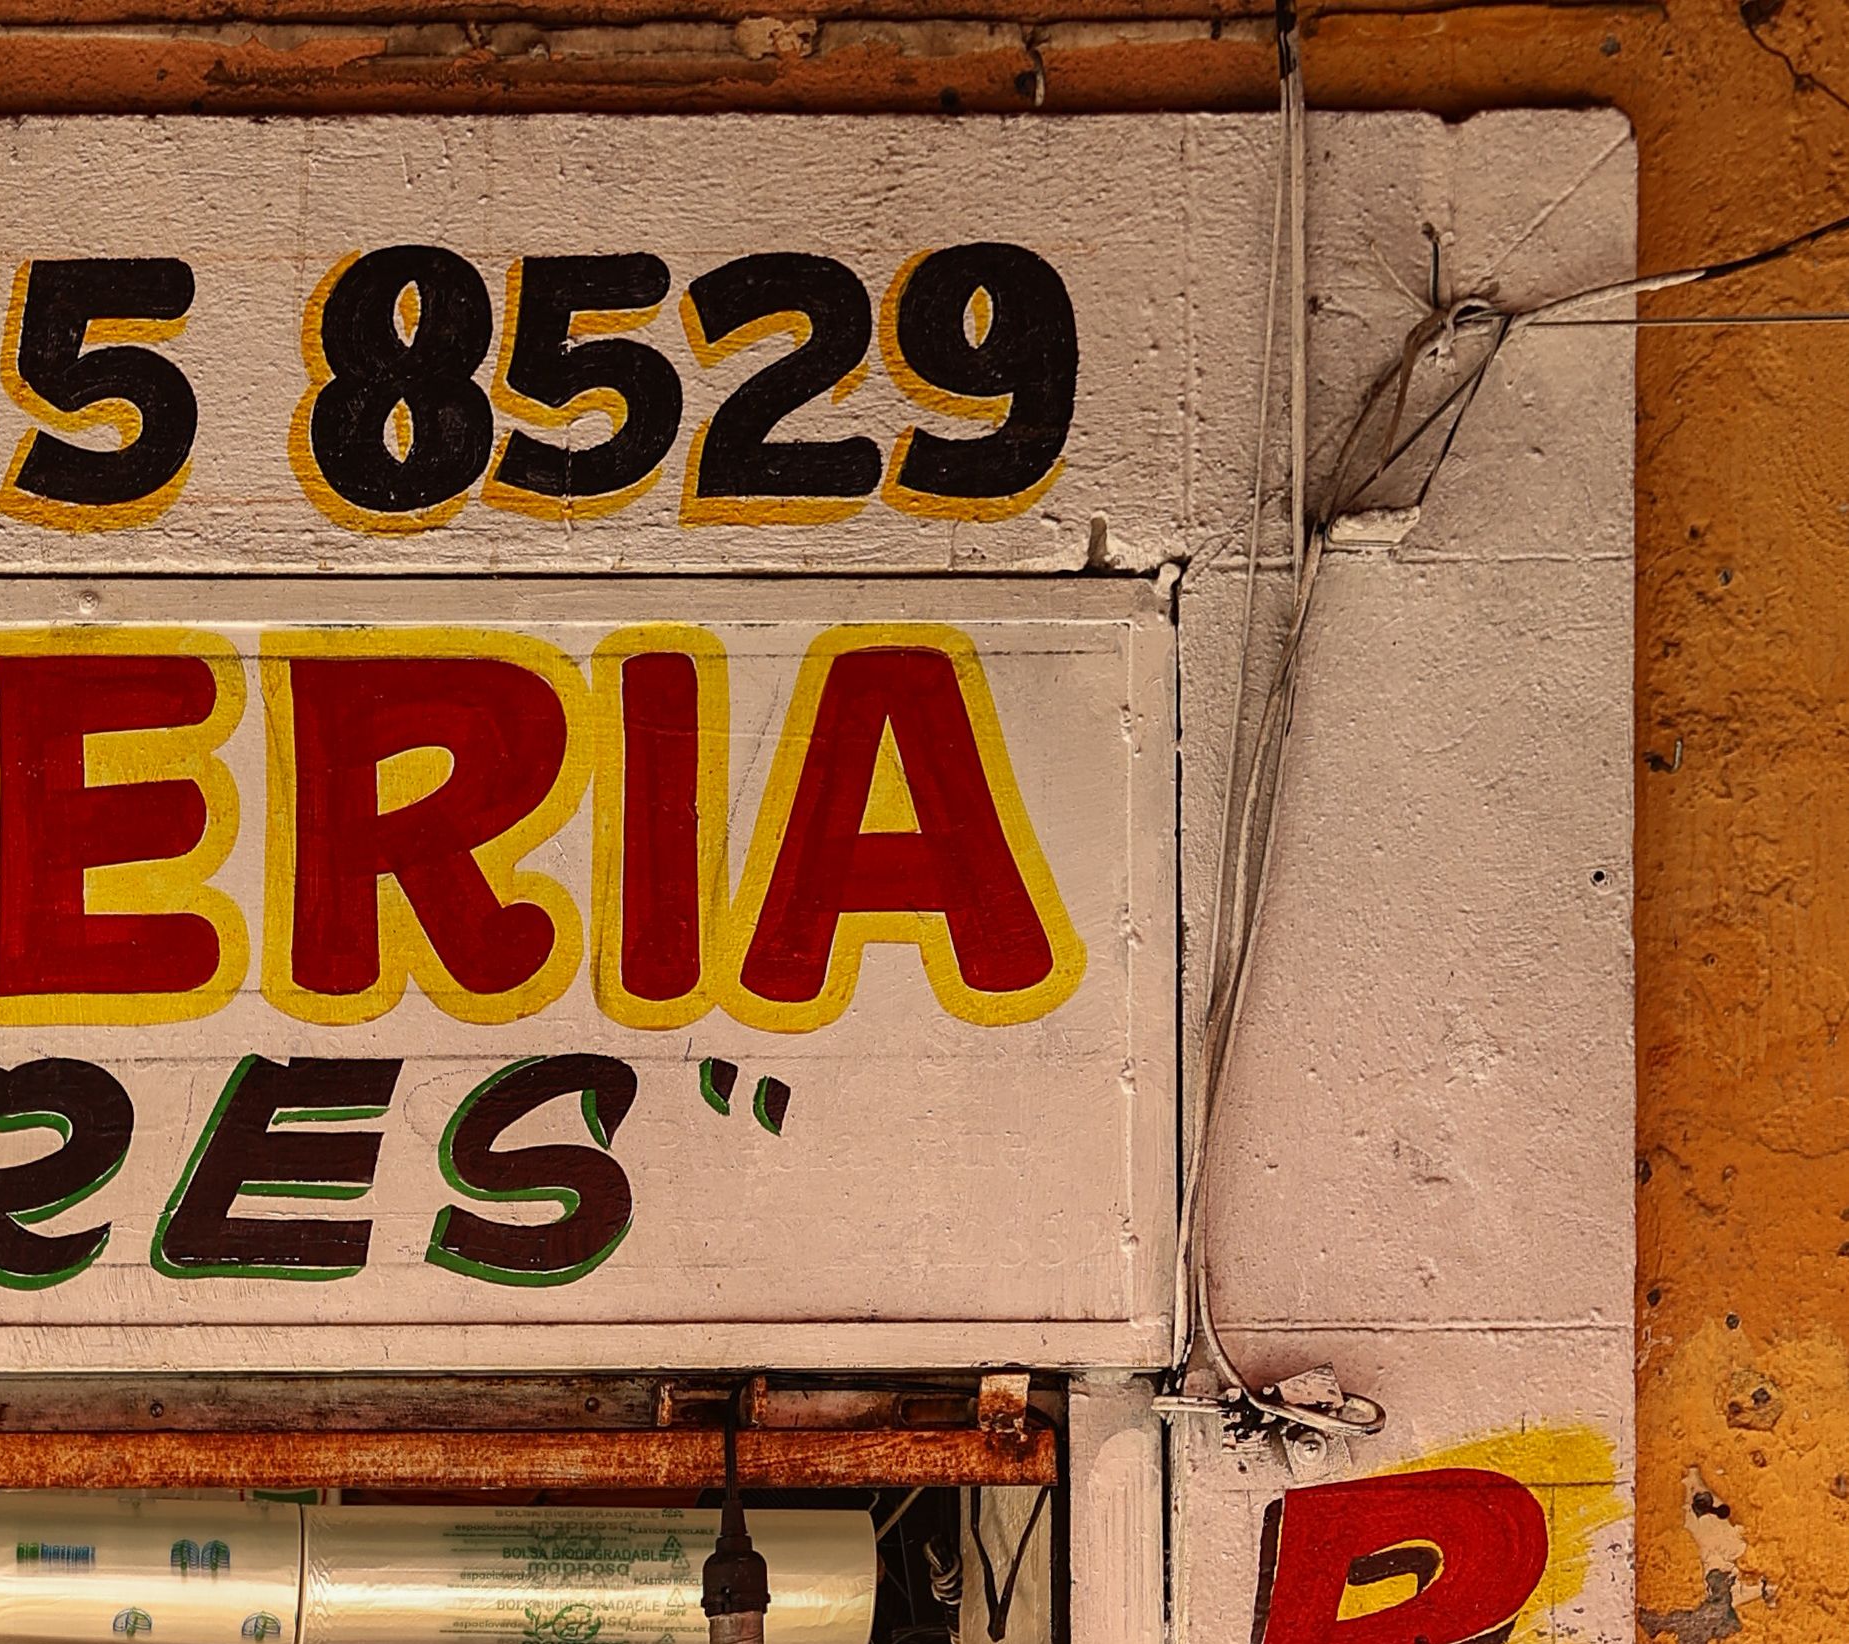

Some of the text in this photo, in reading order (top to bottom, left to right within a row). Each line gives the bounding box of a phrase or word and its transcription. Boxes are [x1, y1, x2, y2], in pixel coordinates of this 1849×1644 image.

[308, 240, 1081, 514] 8529
[502, 1547, 548, 1560] BOLSA
[673, 1577, 703, 1586] RECICL
[665, 1626, 710, 1634] RECICLABL
